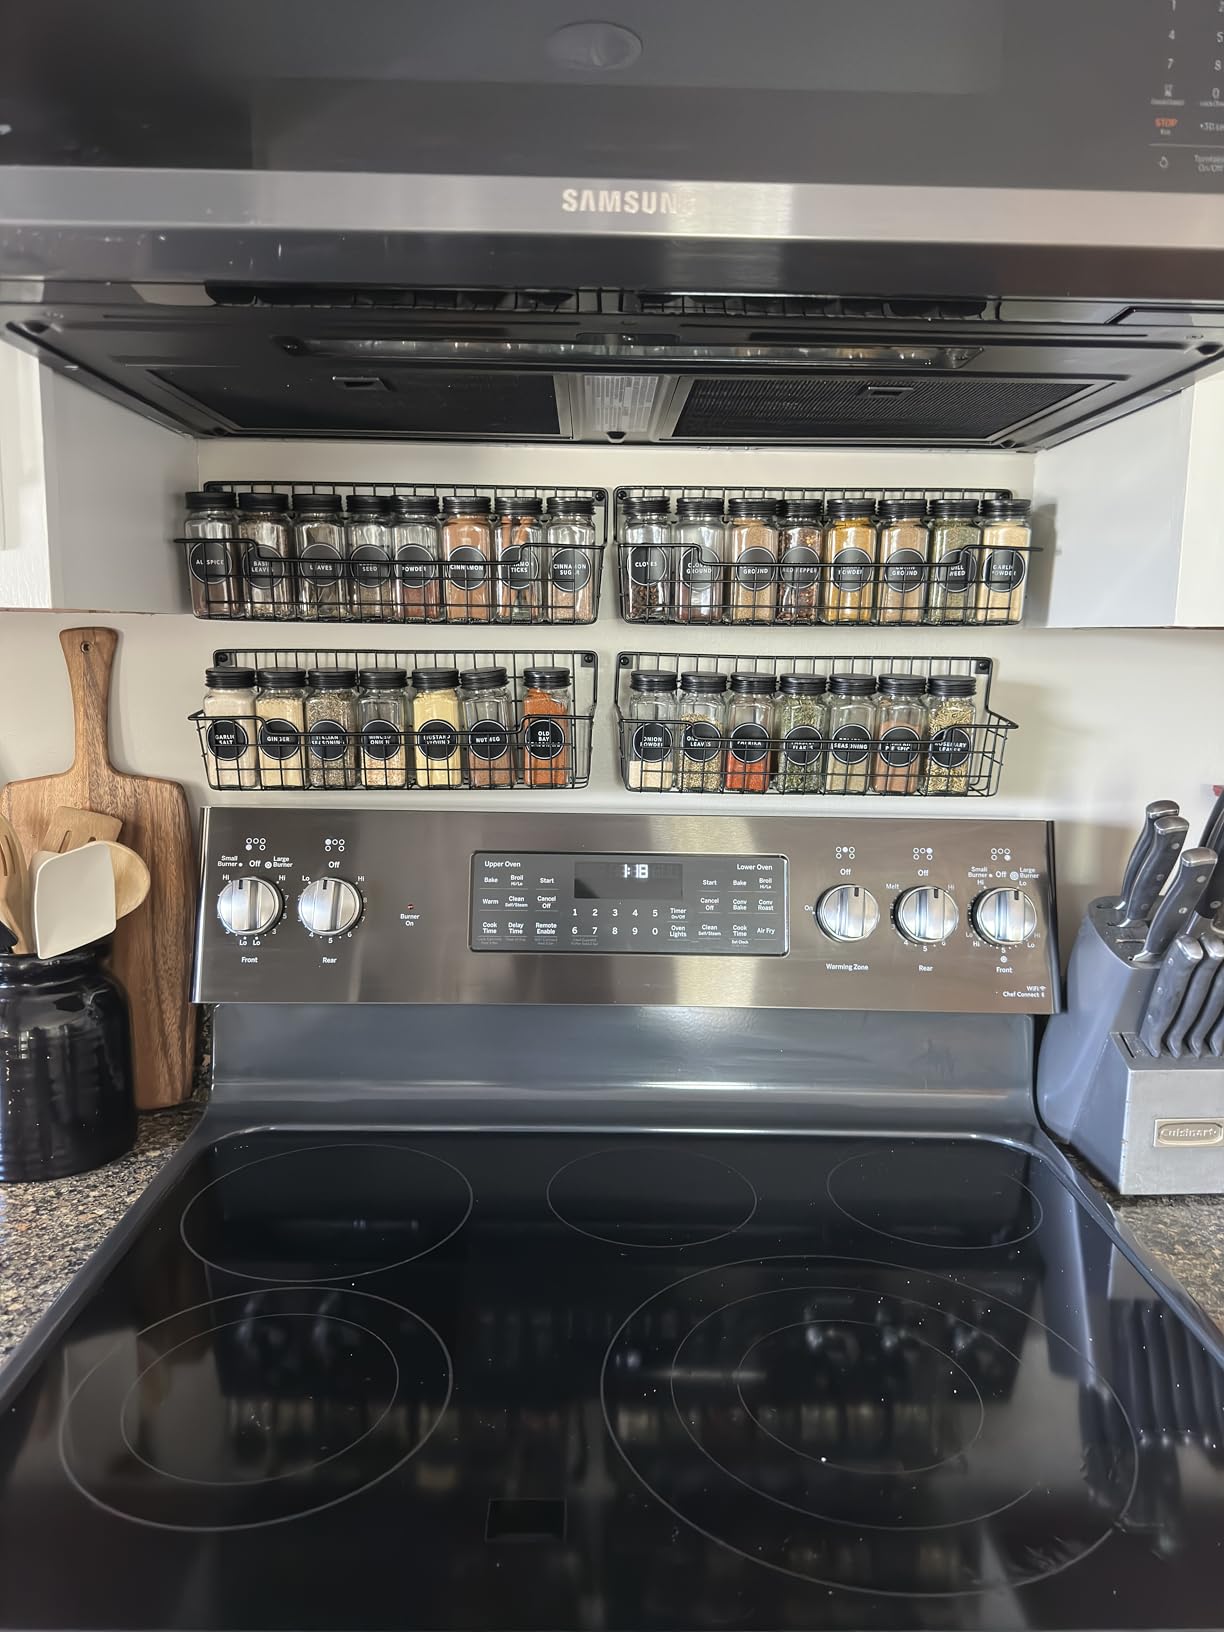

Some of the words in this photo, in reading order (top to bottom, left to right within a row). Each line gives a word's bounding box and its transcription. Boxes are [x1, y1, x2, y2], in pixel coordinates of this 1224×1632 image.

[1169, 30, 1176, 40] 4
[1168, 58, 1174, 69] 7
[562, 188, 697, 214] SAMSUN
[572, 908, 578, 916] 1
[592, 908, 598, 916] 2
[612, 908, 618, 916] 3
[632, 909, 638, 917] 4
[652, 909, 658, 917] 5
[572, 926, 578, 934] 6
[592, 926, 598, 934] 7
[612, 926, 618, 935] 8
[632, 927, 638, 935] 9
[652, 928, 658, 936] 0
[826, 964, 852, 972] Warming
